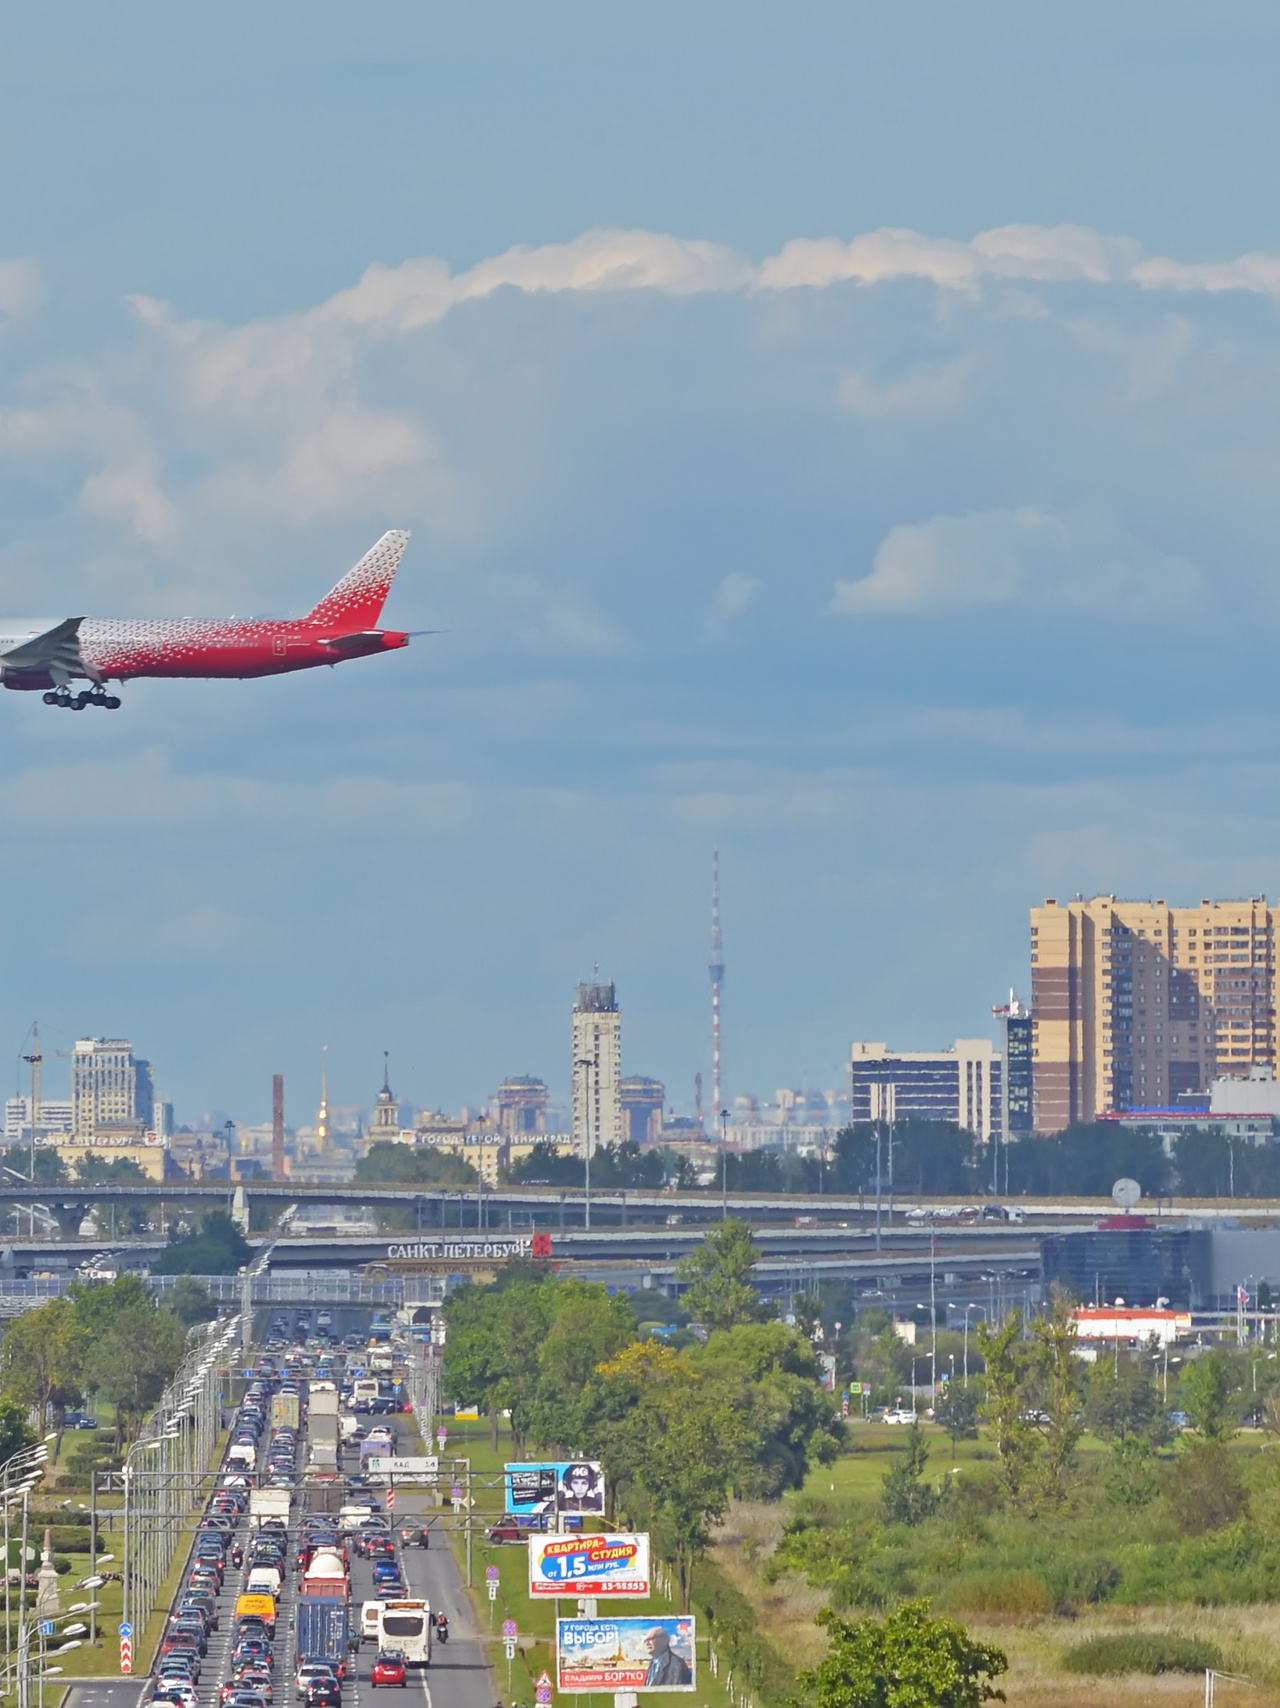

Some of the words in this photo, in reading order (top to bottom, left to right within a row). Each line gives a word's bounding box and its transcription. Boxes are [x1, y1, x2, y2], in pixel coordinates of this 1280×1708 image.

[572, 1467, 589, 1477] 4G
[547, 1538, 604, 1554] КВАРТИРА-
[591, 1546, 633, 1561] СТУДИЯ
[557, 1556, 586, 1578] 1,5
[570, 1624, 599, 1632] ГОРОДА
[564, 1632, 619, 1645] ВЫБОР!
[604, 1672, 644, 1682] БОРТКО
